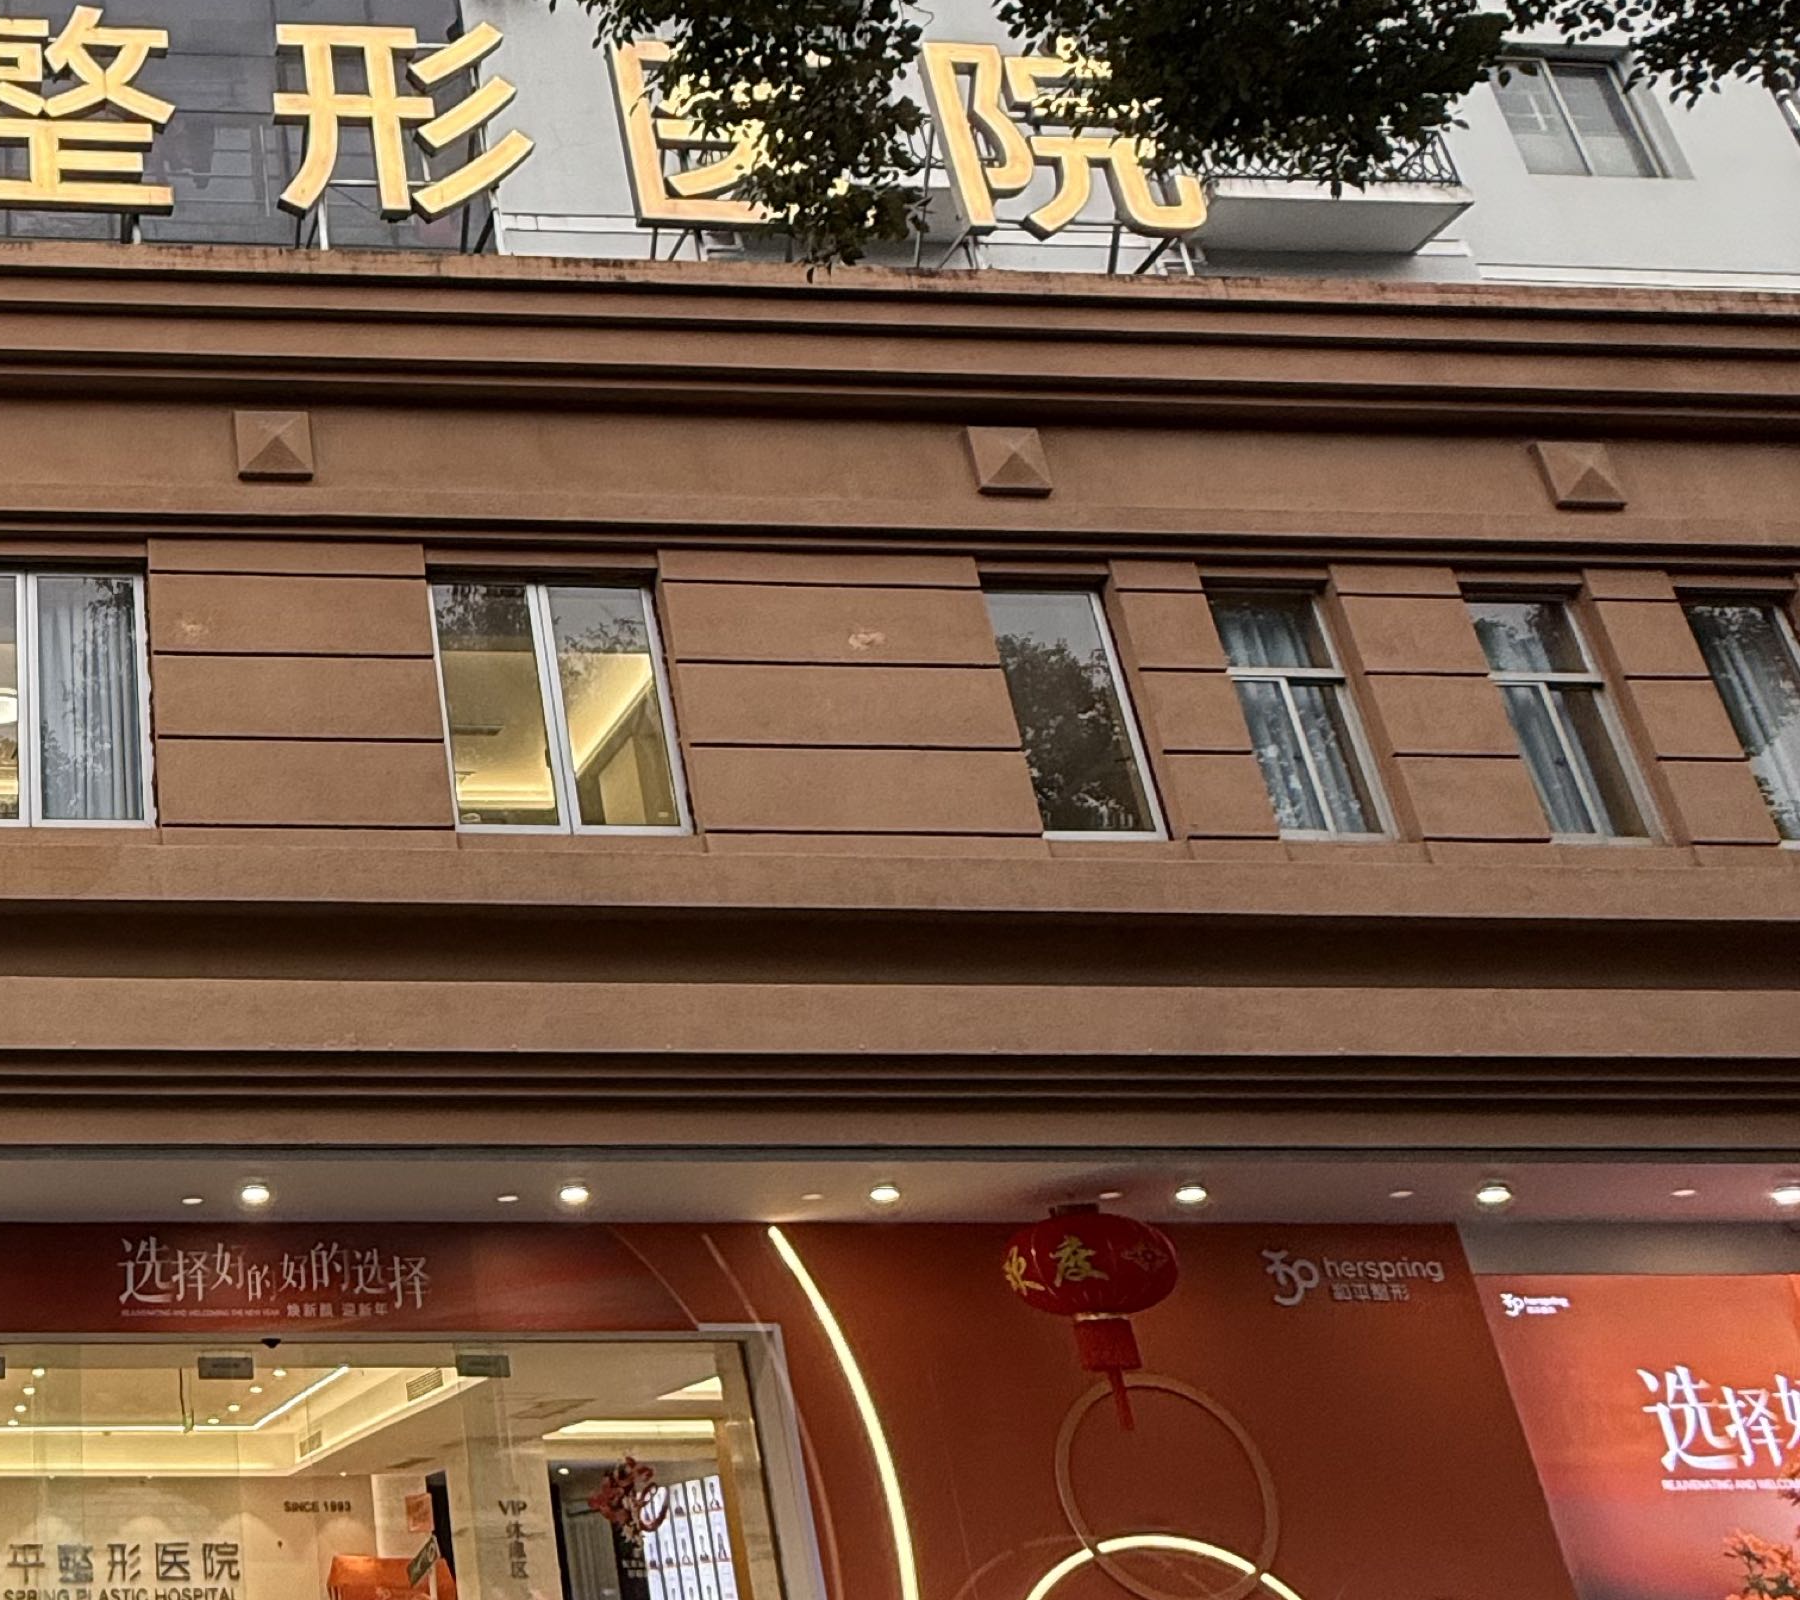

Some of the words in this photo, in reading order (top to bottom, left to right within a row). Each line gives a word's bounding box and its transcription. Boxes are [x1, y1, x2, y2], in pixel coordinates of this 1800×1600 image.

[117, 1236, 432, 1310] 选择好的好的选择
[1324, 1256, 1445, 1283] herspring
[498, 1500, 528, 1516] VIP
